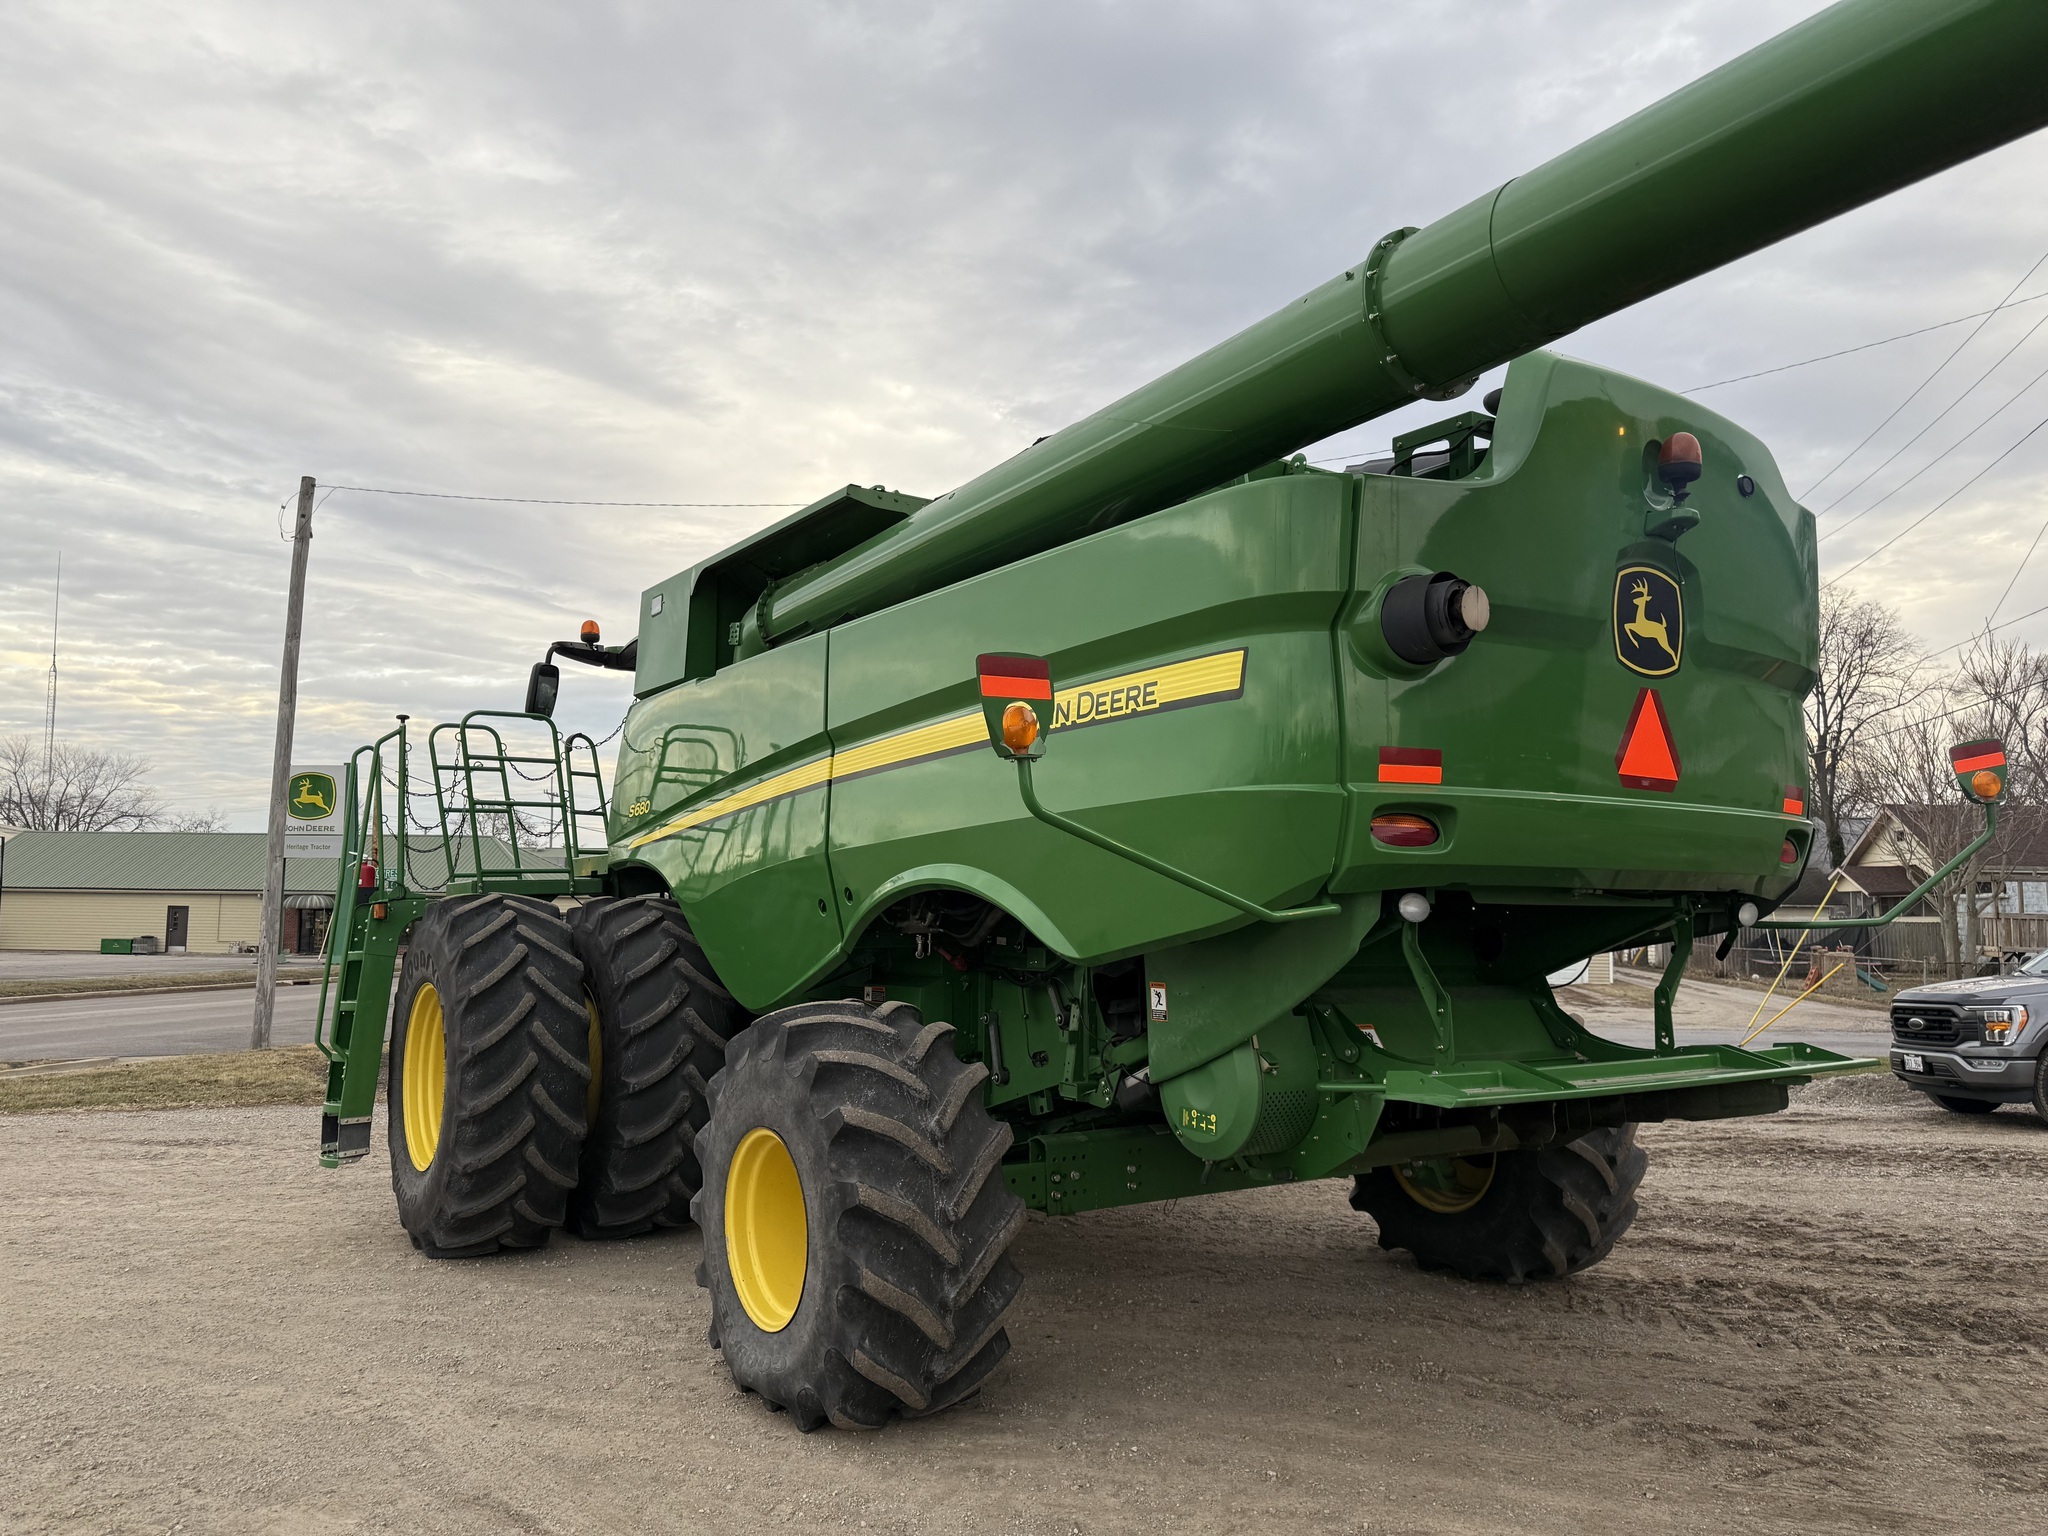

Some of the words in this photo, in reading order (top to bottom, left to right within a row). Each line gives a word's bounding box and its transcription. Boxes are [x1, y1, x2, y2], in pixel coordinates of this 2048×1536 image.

[1076, 680, 1159, 723] DEERE
[628, 800, 651, 818] S680
[305, 824, 336, 832] DEERE
[286, 843, 309, 851] Heritage
